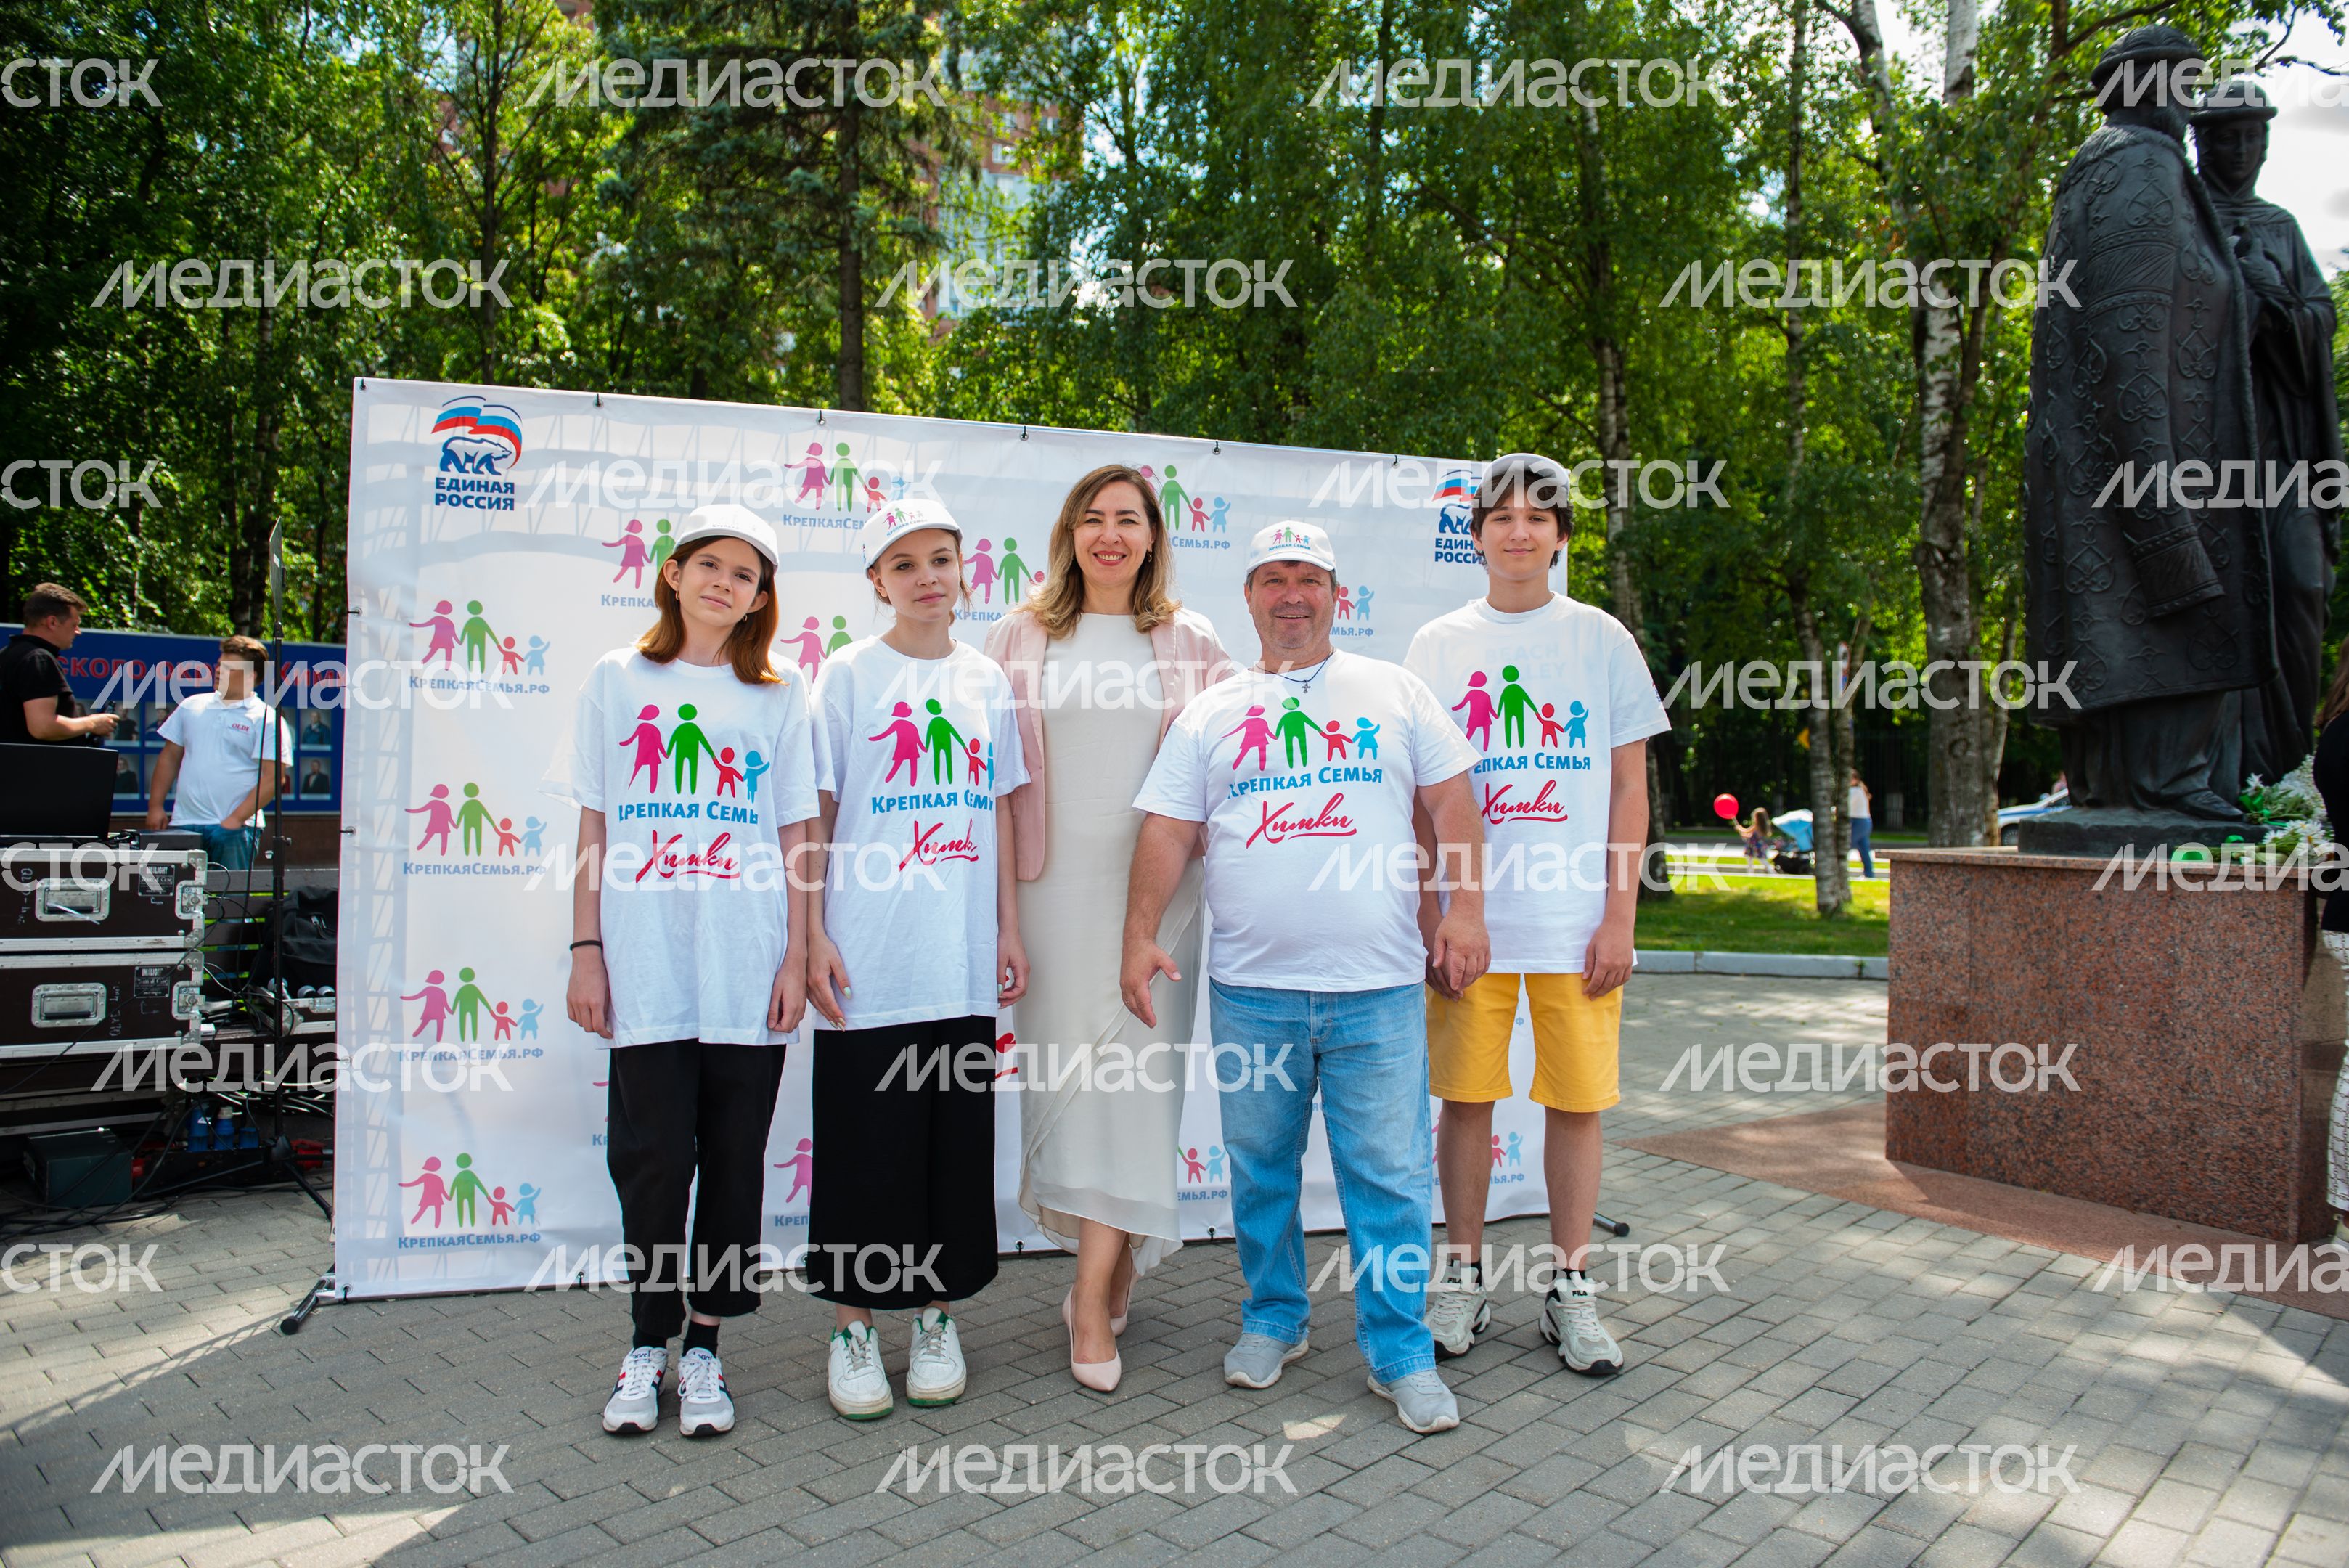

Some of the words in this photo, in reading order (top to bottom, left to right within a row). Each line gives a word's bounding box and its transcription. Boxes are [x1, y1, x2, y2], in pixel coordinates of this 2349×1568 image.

[435, 477, 515, 494] ЕДИНАЯ
[435, 493, 515, 511] РОССИЯ
[1169, 536, 1230, 550] СЕМЬЯ.РФ
[1435, 538, 1475, 550] ЕДИН
[1435, 551, 1482, 565] РОССИ
[954, 609, 1005, 621] КРЕПКА
[1330, 626, 1373, 637] МЬЯ.РФ
[155, 660, 218, 687] ОКР
[1481, 779, 1568, 825] Химки
[1246, 792, 1357, 849] Химки
[636, 829, 741, 883] Химки
